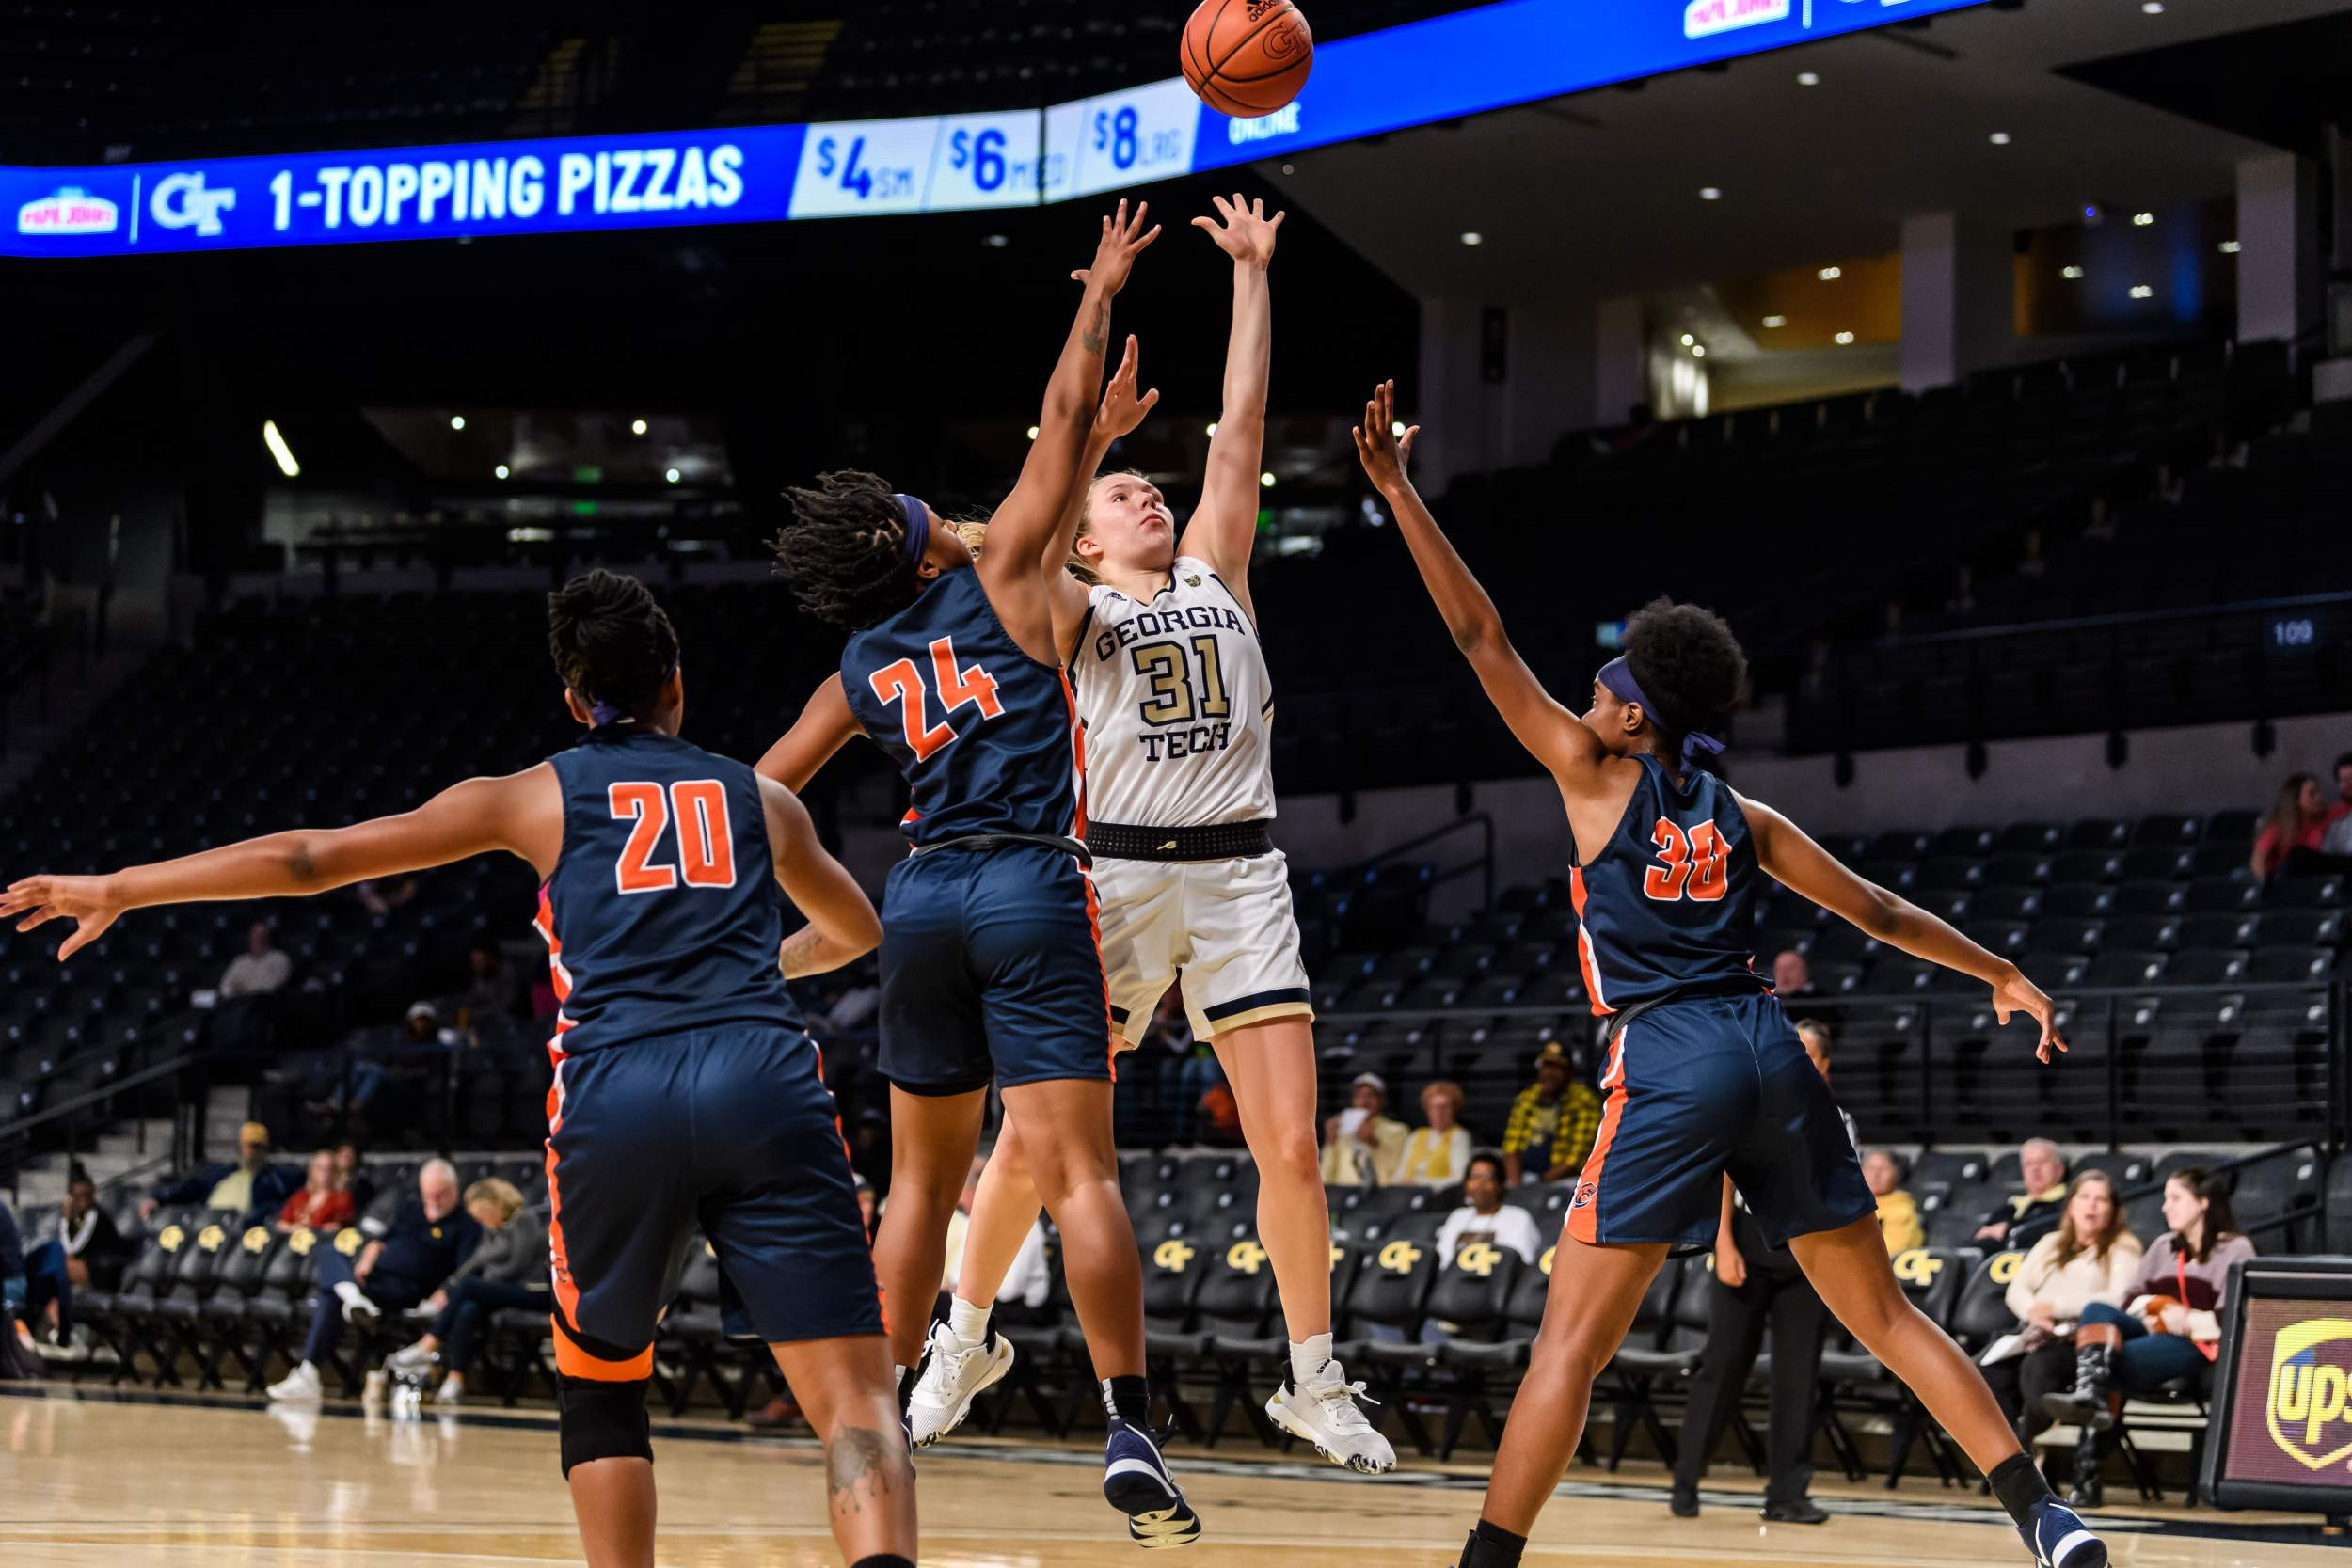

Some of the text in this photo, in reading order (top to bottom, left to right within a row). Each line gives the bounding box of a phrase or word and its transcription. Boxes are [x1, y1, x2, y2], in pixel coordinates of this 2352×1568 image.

[1249, 0, 1279, 22] adida
[270, 144, 744, 230] 1-TOPPING PIZZAS
[1095, 607, 1245, 662] GEORGIA
[868, 634, 1006, 762] 24
[1131, 634, 1231, 727] 31
[1139, 722, 1232, 762] TECH
[608, 779, 737, 895] 20
[1644, 816, 1732, 901] 30
